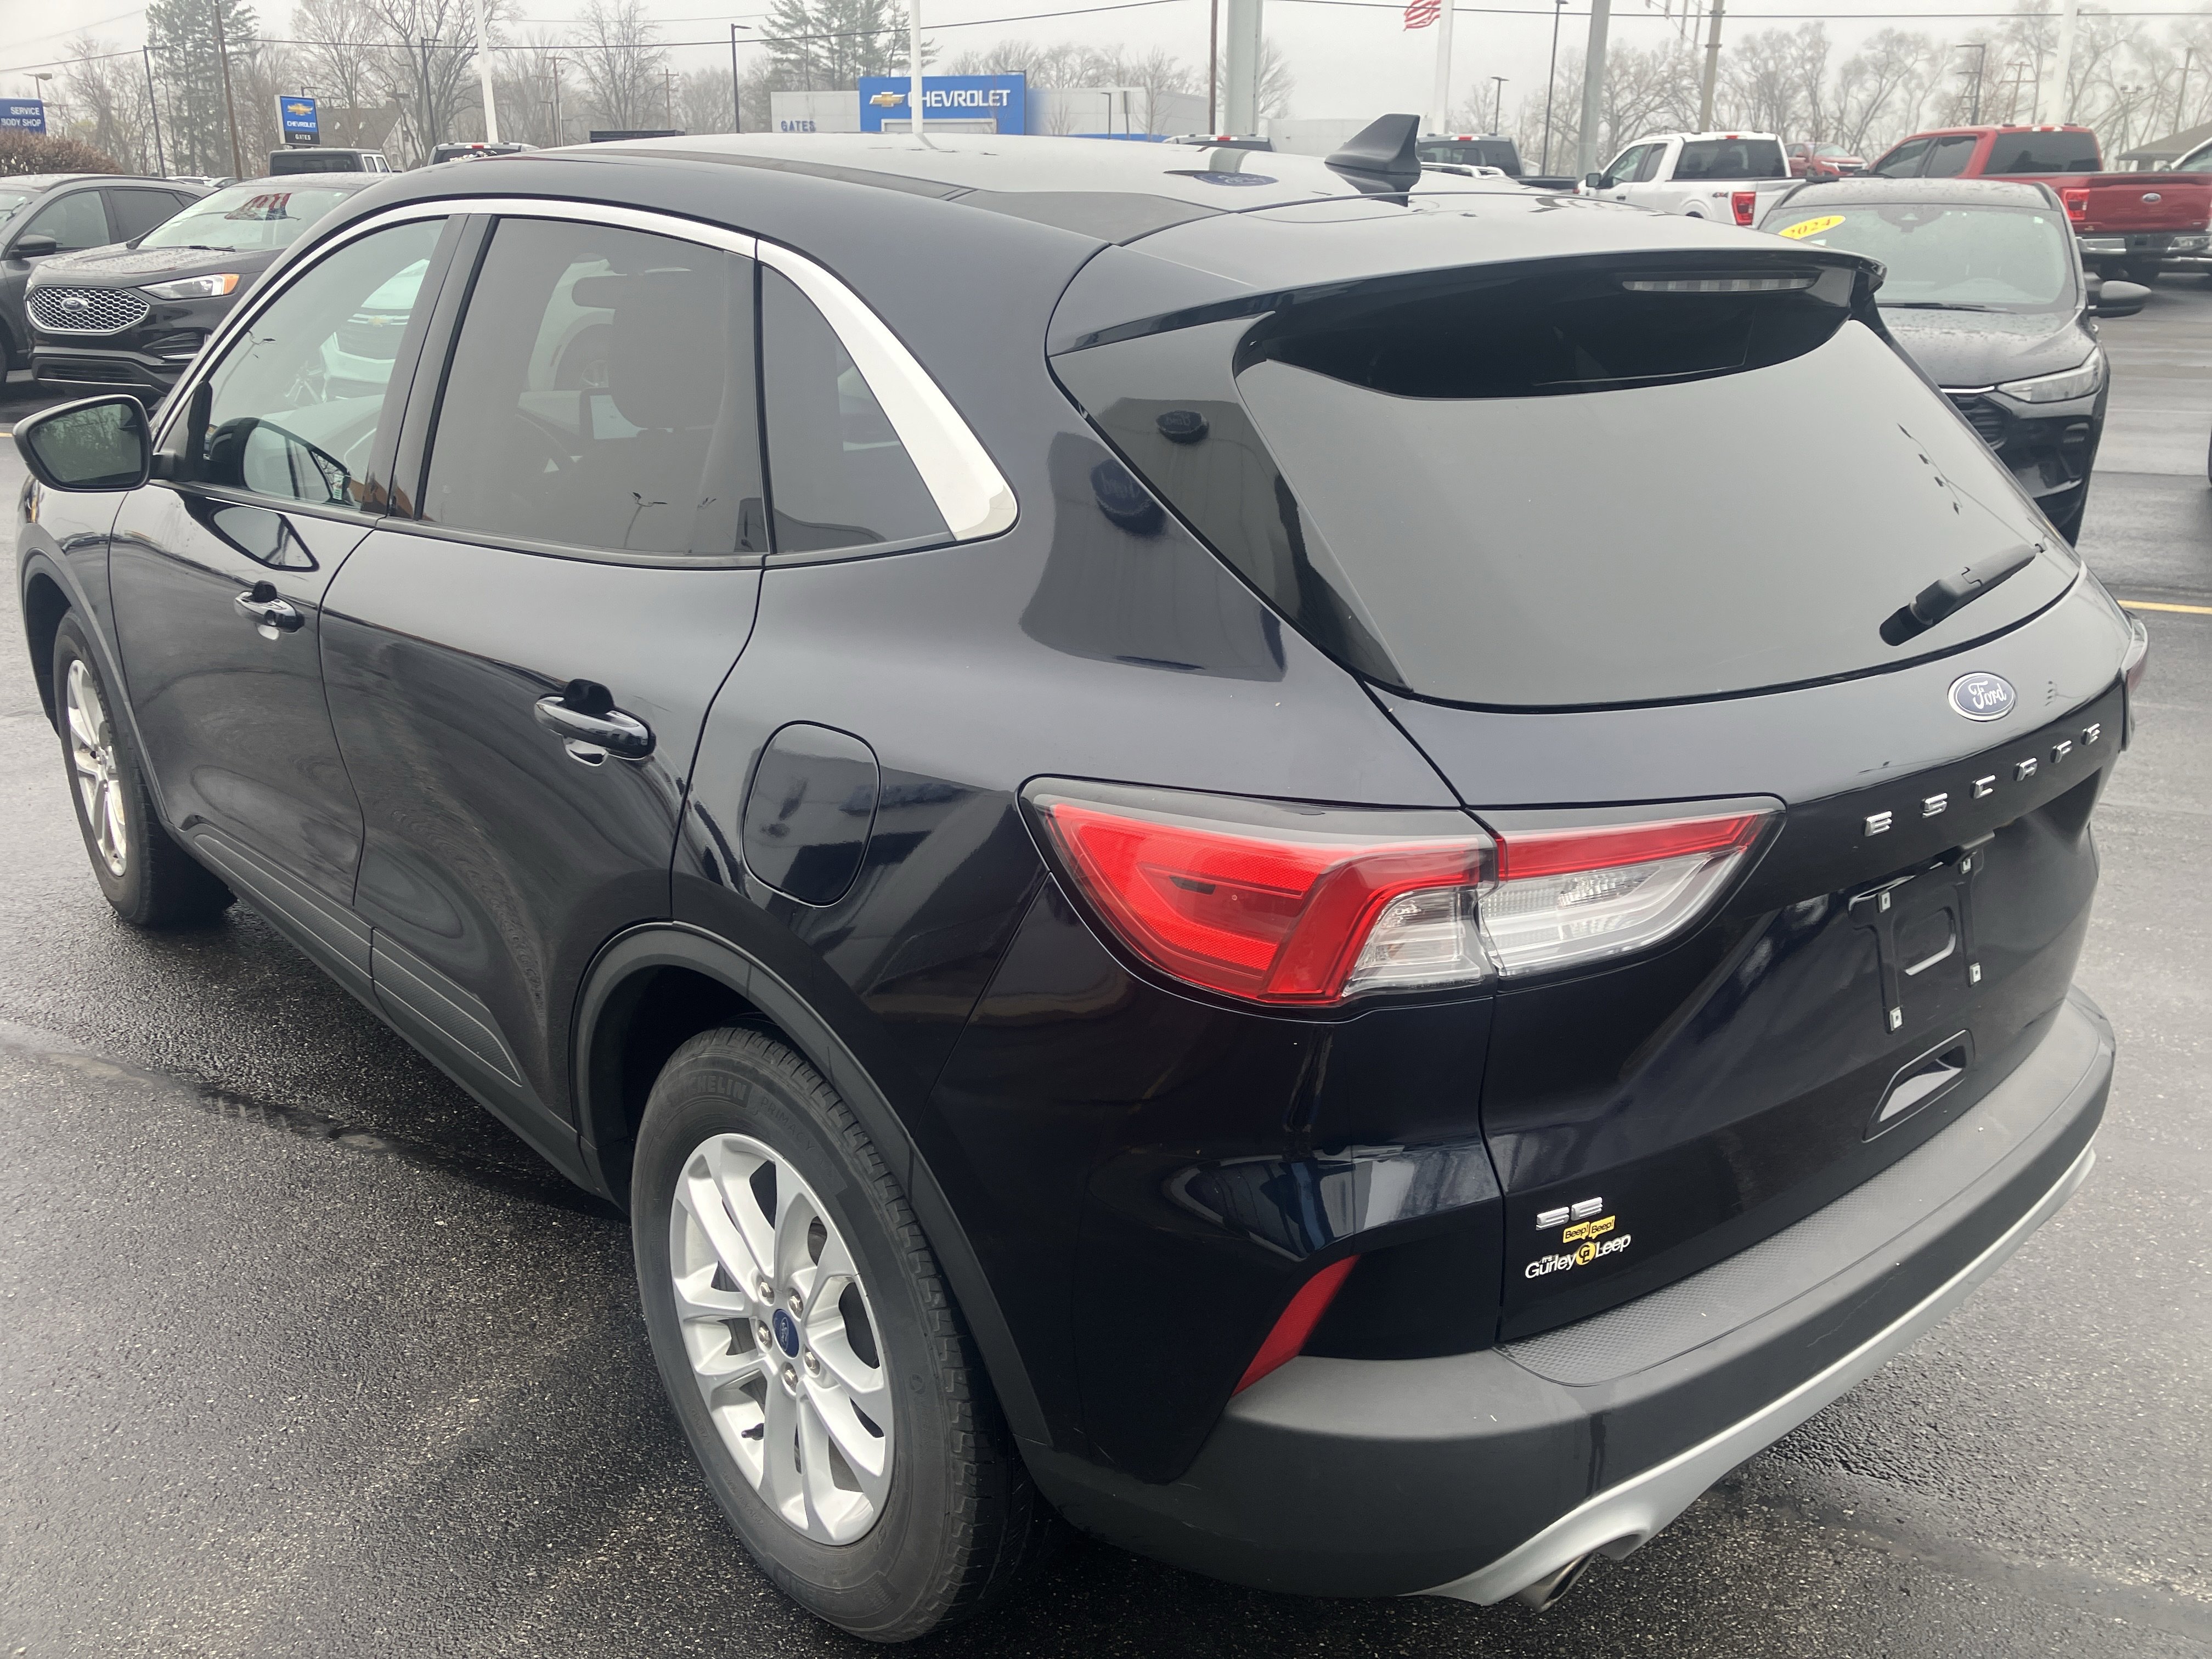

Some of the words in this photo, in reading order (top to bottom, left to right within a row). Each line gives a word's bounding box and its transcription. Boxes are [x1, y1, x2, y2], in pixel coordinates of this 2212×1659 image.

[1, 117, 20, 126] BODY
[22, 119, 41, 127] SHOP
[10, 106, 40, 115] SERVICE
[781, 120, 816, 132] GATES
[1968, 680, 2007, 709] Ford
[1865, 723, 2101, 837] ESCAPE
[1536, 1197, 1603, 1231] SE
[1565, 1224, 1589, 1239] Beep!
[1592, 1219, 1614, 1233] Beep!
[1525, 1254, 1577, 1278] Gurley
[1595, 1234, 1632, 1259] Leep
